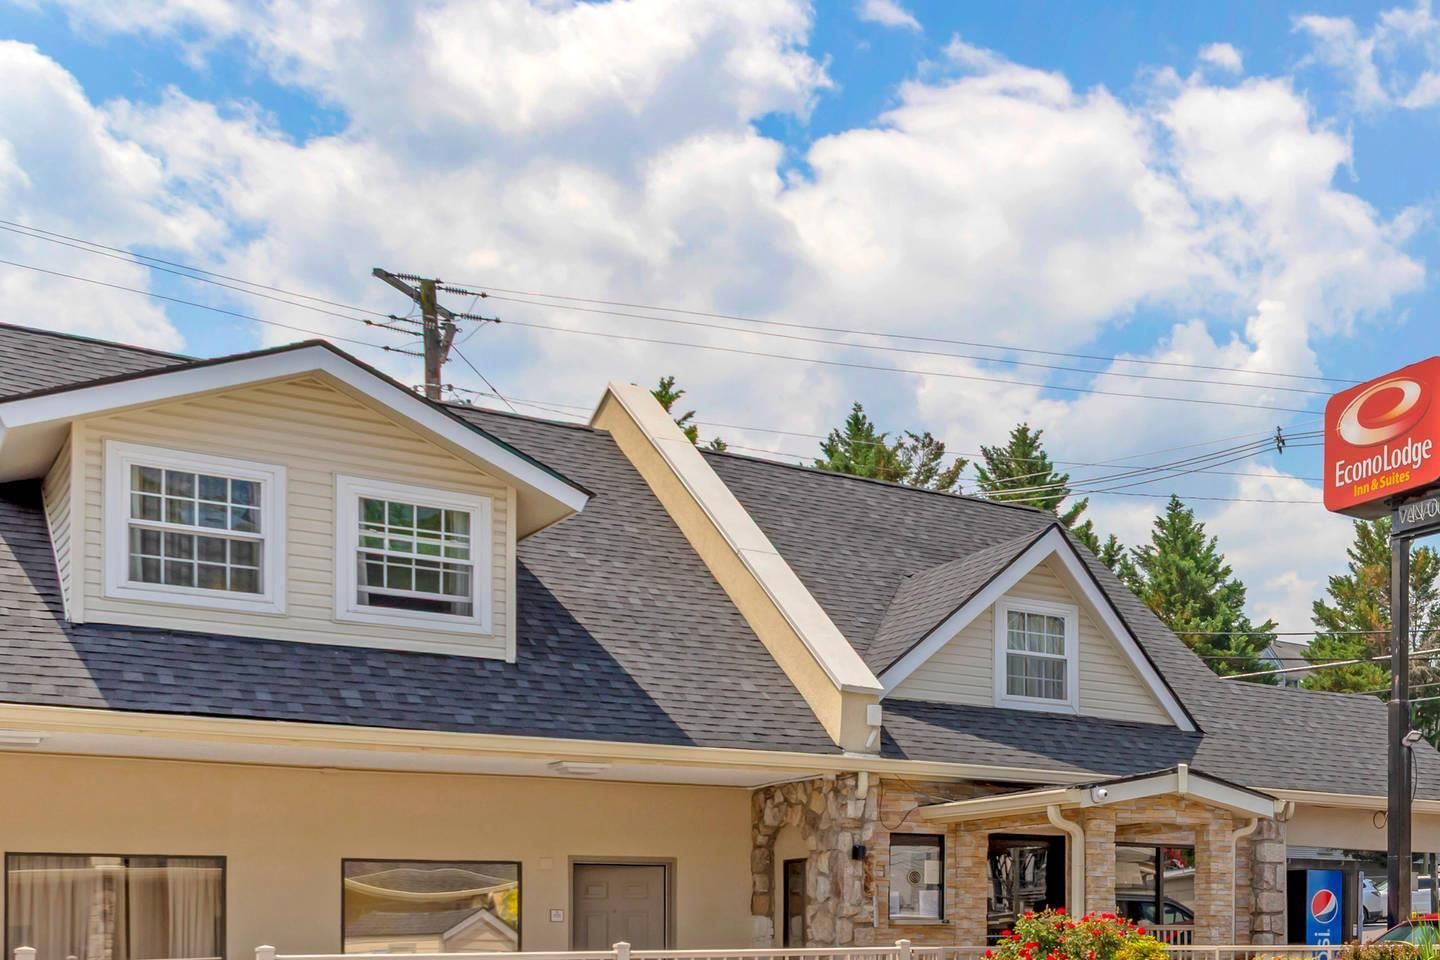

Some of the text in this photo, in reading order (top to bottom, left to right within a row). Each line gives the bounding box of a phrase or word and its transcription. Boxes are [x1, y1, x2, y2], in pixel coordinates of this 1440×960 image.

[1335, 437, 1433, 488] EconoLodge
[1353, 471, 1411, 497] Inn & Suites
